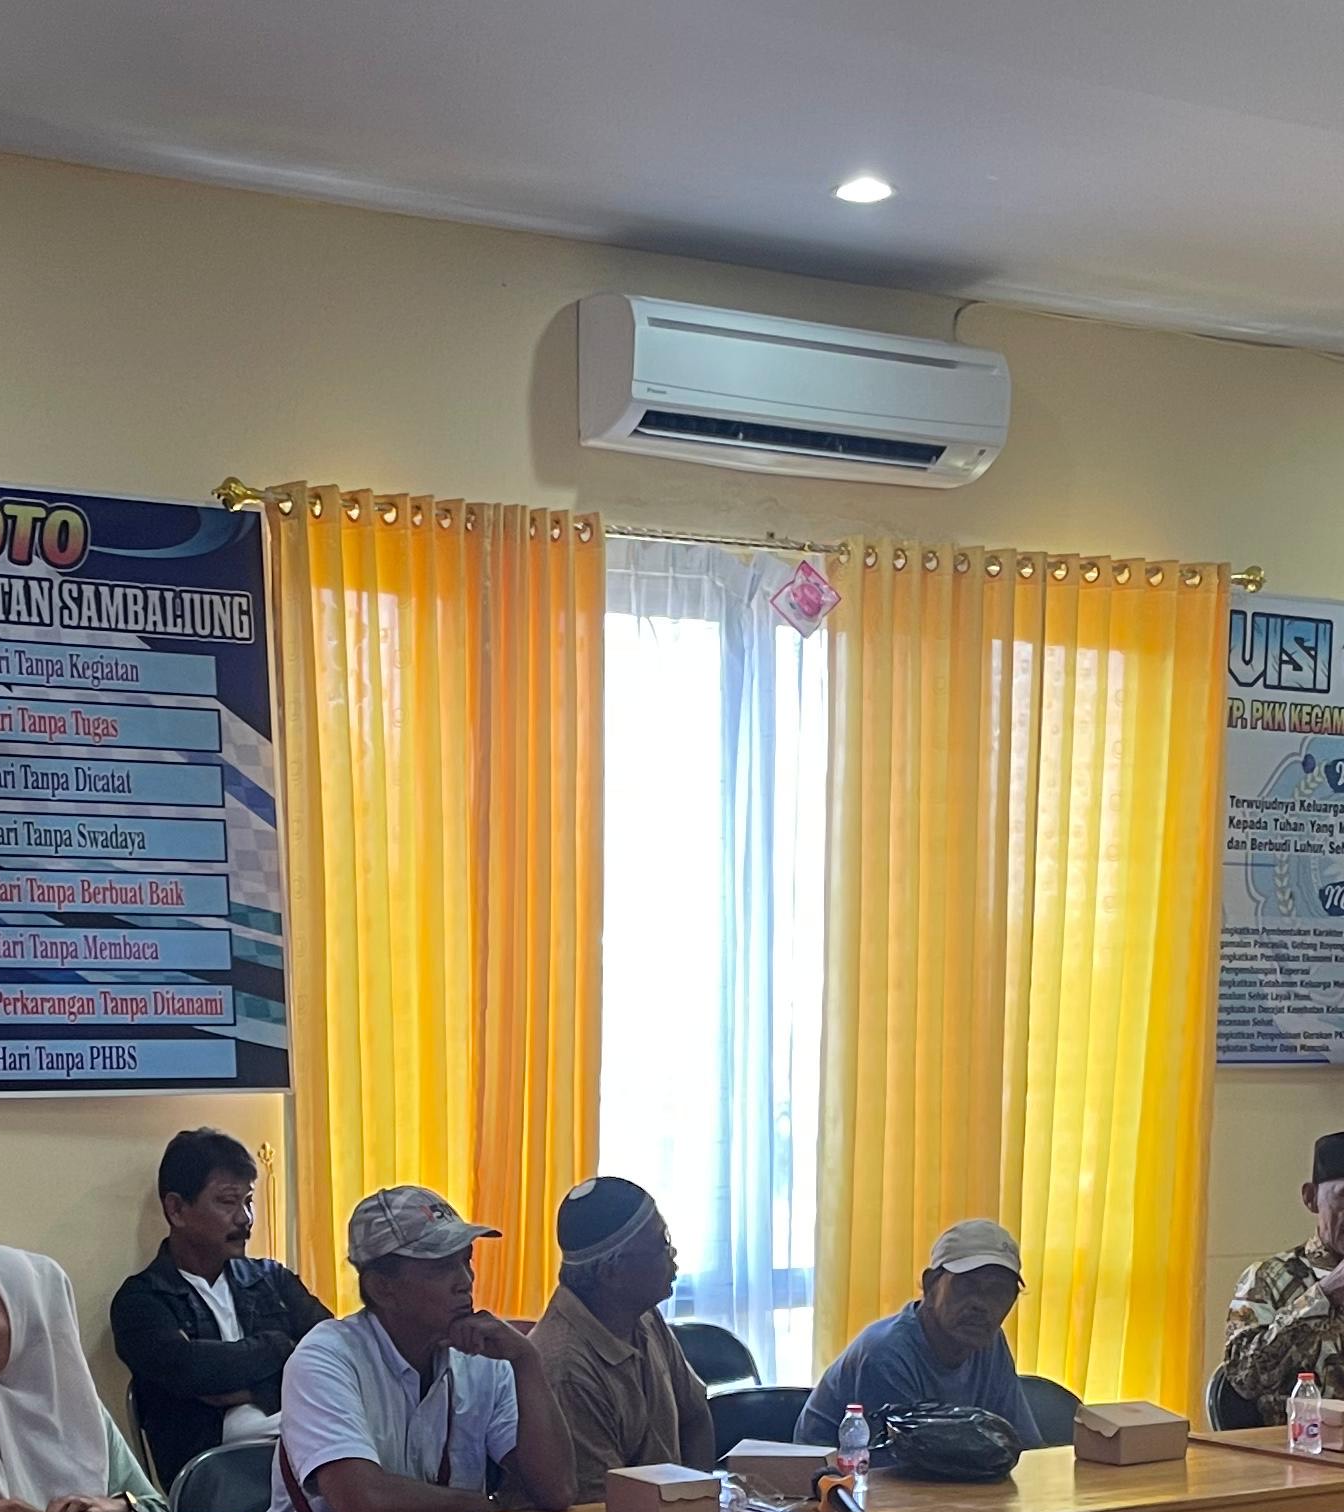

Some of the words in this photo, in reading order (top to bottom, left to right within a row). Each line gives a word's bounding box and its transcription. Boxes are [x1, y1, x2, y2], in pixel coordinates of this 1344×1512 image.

[61, 582, 251, 640] SAMBALIUNG
[1227, 609, 1334, 694] VISI
[14, 649, 64, 684] Tanpa
[69, 653, 139, 687] Kegiatan
[18, 707, 67, 742] Tanpa
[71, 710, 118, 744] Tugas
[1250, 699, 1287, 731] PKK
[20, 764, 70, 798] Tanpa
[74, 767, 132, 794] Dicatat
[1299, 799, 1344, 817] Keluarga
[23, 821, 73, 854] Tanpa
[78, 824, 146, 856] Swadaya
[1228, 816, 1268, 834] Kepada
[1273, 818, 1304, 833] Tuhan
[1310, 820, 1334, 837] Yang
[1227, 837, 1247, 851] dan
[1250, 838, 1291, 853] Berbudi
[26, 878, 75, 910] Tanpa
[80, 879, 144, 905] Berbuat
[149, 880, 185, 906] Baik
[32, 934, 78, 966] Tanpa
[83, 935, 159, 960] Membaca
[100, 991, 147, 1022] Tanpa
[153, 991, 223, 1016] Ditanami
[36, 1046, 85, 1077] Tanpa
[90, 1045, 138, 1070] PHBS
